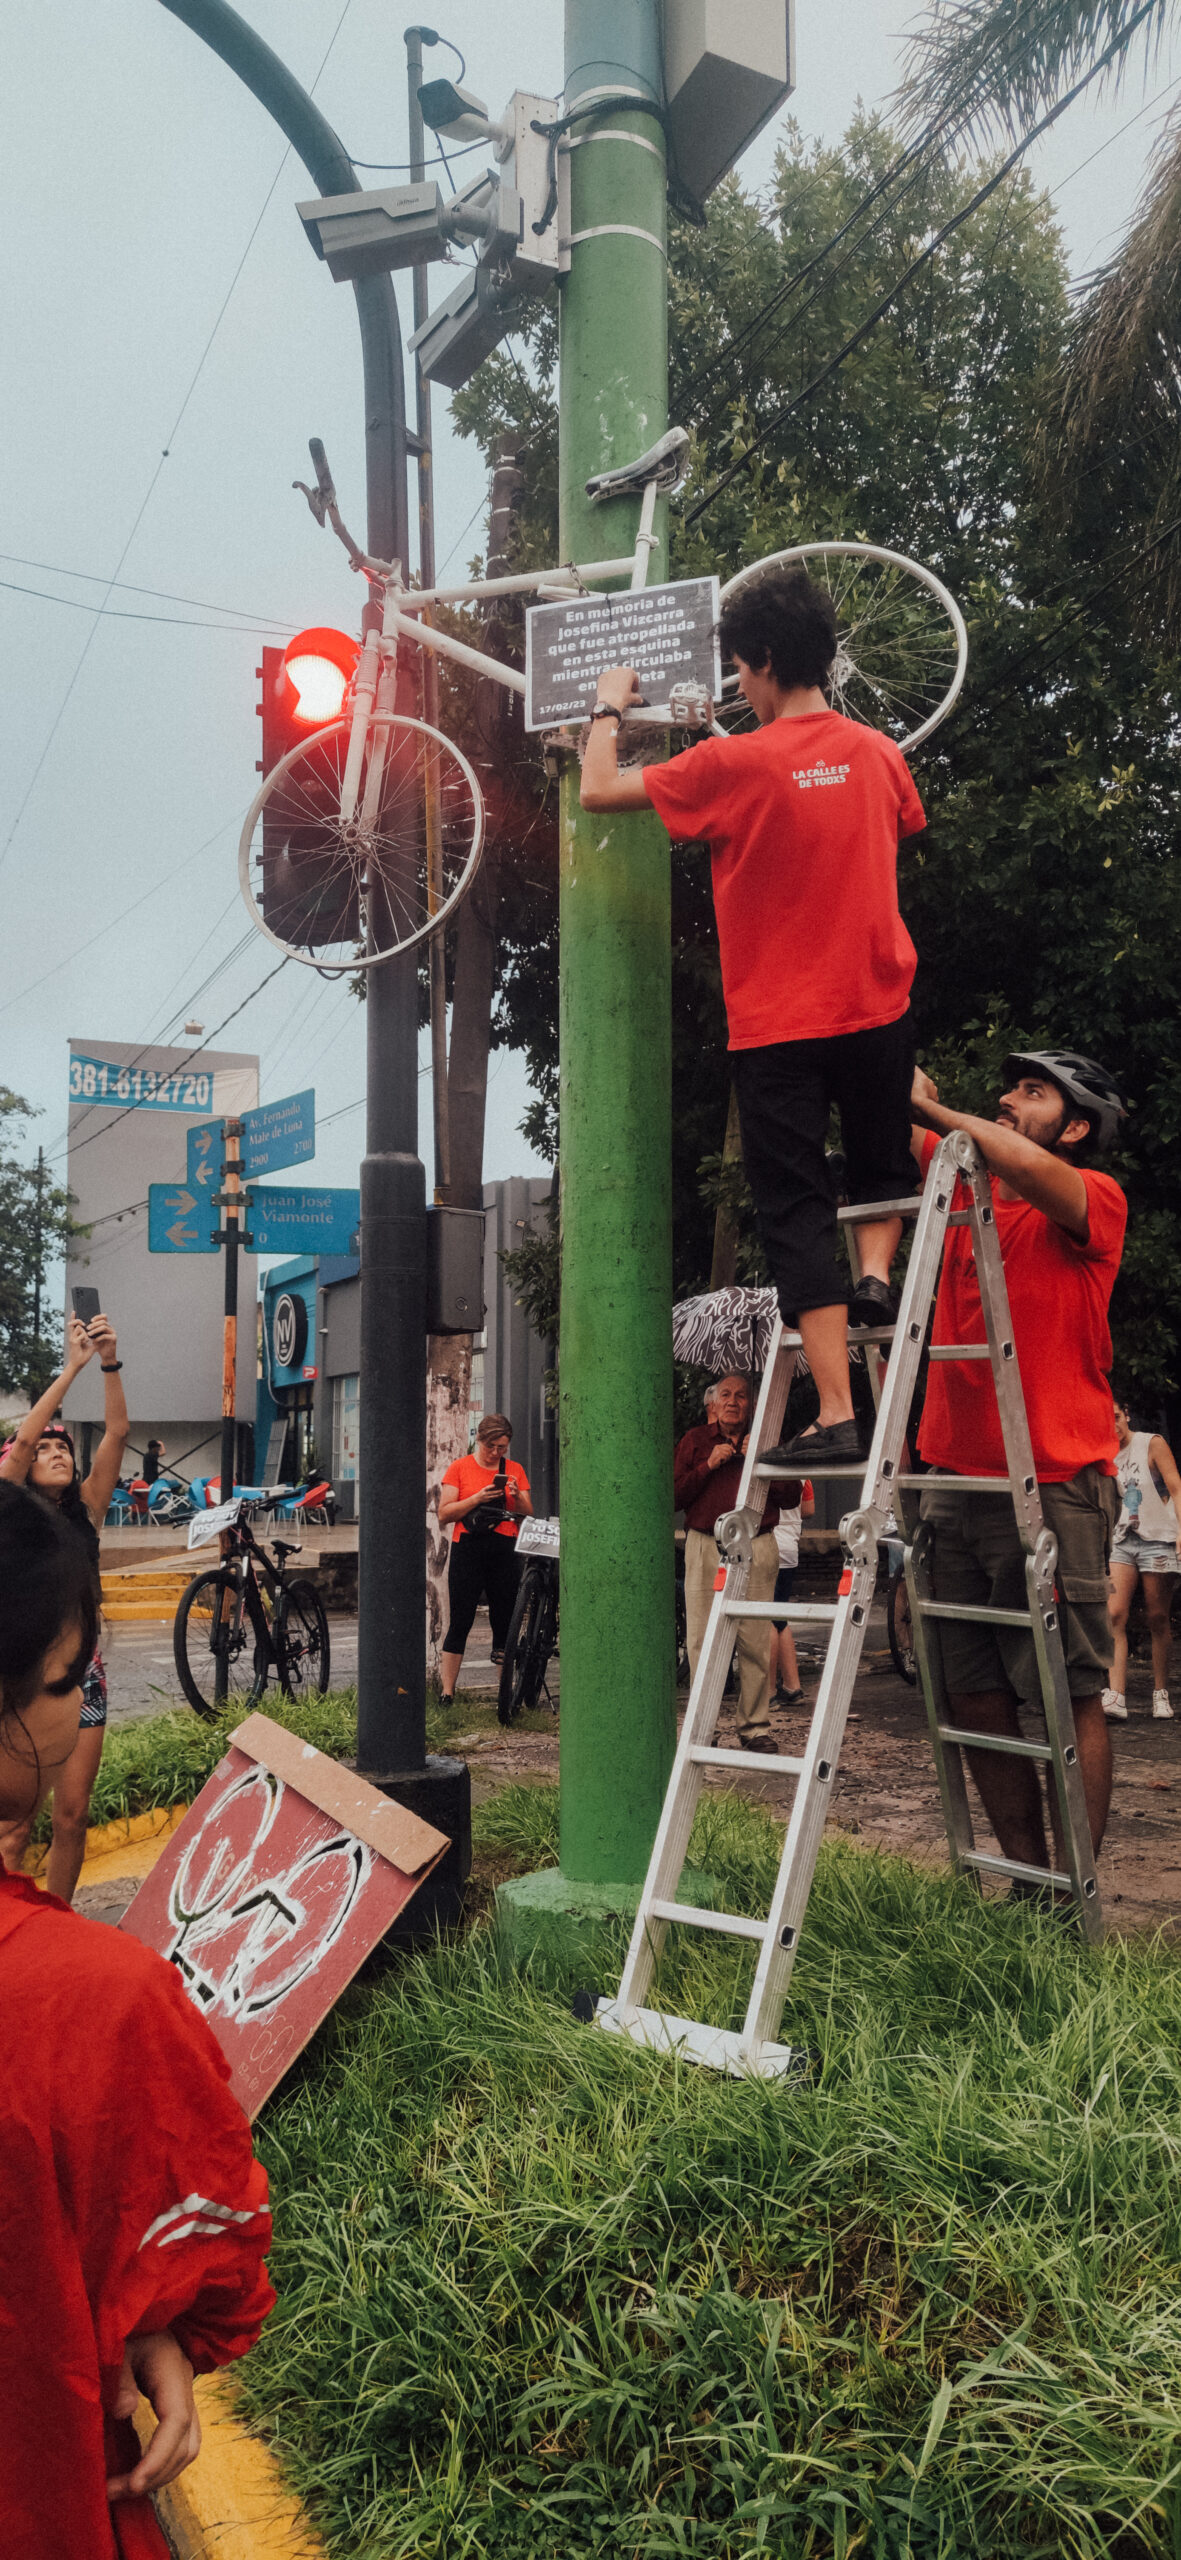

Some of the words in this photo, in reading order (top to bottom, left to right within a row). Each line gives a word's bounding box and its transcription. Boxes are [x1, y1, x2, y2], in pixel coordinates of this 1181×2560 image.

[566, 611, 584, 622] En
[588, 599, 653, 619] memoria
[657, 595, 676, 607] de
[558, 621, 619, 641] Josefina
[622, 609, 684, 627] Vizcarra
[548, 642, 576, 656] que
[579, 638, 605, 649] fue
[608, 620, 695, 645] atropellada
[563, 655, 581, 666] en
[585, 649, 616, 662] esta
[620, 637, 680, 655] esquina
[552, 662, 618, 682] mientras
[622, 650, 692, 669] circulaba
[578, 680, 597, 692] en
[539, 699, 586, 714] 17/02/23
[792, 770, 806, 780] LA
[807, 766, 837, 778] CALLE
[838, 764, 850, 774] ES
[799, 779, 812, 789] DE
[814, 774, 846, 787] TODXS
[250, 1119, 262, 1129] Av.
[264, 1102, 301, 1126] Fernando
[250, 1131, 270, 1145] Mate
[272, 1125, 281, 1138] de
[284, 1120, 303, 1135] Luna
[262, 1194, 296, 1208] Juan
[302, 1195, 332, 1209] José
[262, 1210, 334, 1224] Viamonte
[532, 1523, 546, 1532] YO
[547, 1524, 560, 1536] SO
[521, 1532, 560, 1546] JOSEFI
